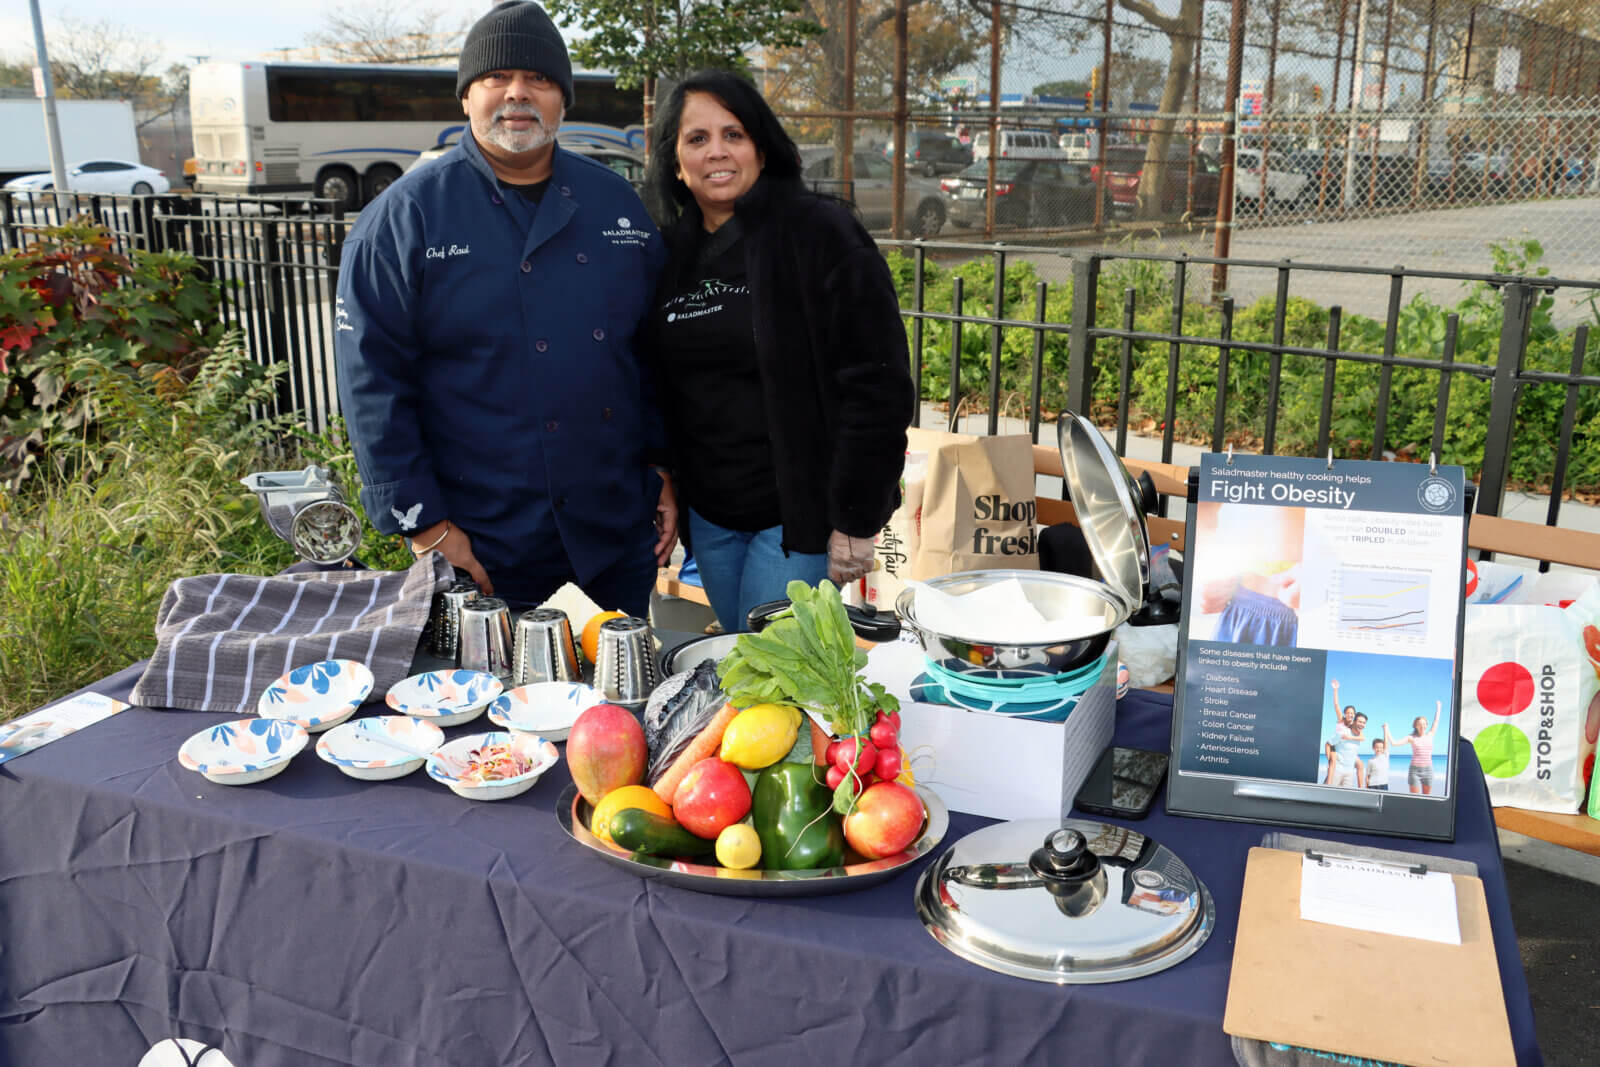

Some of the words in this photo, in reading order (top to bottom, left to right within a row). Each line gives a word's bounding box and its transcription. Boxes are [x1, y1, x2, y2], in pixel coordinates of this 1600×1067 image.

[426, 246, 445, 259] Chef
[448, 245, 470, 256] Raul
[1211, 467, 1268, 478] Saladmaster
[1270, 470, 1303, 481] healthy
[1306, 472, 1343, 484] cooking
[1345, 474, 1372, 484] helps
[1211, 480, 1265, 502] Fight
[1271, 483, 1355, 509] Obesity
[974, 495, 1036, 527] Shop
[1365, 526, 1406, 536] DOUBLED
[1352, 535, 1385, 544] TRIPLED
[1199, 647, 1221, 656] Some
[1222, 649, 1254, 659] diseases
[1256, 651, 1271, 660] that
[1272, 653, 1290, 662] have
[1292, 655, 1312, 663] been
[1199, 656, 1221, 666] linked
[1222, 658, 1230, 666] to
[1231, 659, 1258, 670] obesity
[1260, 662, 1288, 671] include
[1206, 673, 1240, 683] Diabetes
[1204, 686, 1226, 694] Heart
[1228, 687, 1258, 696] Disease
[1204, 697, 1228, 706] Stroke
[1203, 708, 1227, 717] Breast
[1229, 710, 1256, 720] Cancer
[1202, 719, 1225, 729] Colon
[1226, 722, 1254, 731] Cancer
[1537, 664, 1555, 780] STOP&SHOP
[1201, 731, 1228, 742] Kidney
[1229, 734, 1255, 743] Failure
[1200, 743, 1260, 755] Arteriosclerosis
[1199, 755, 1229, 764] Arthritis
